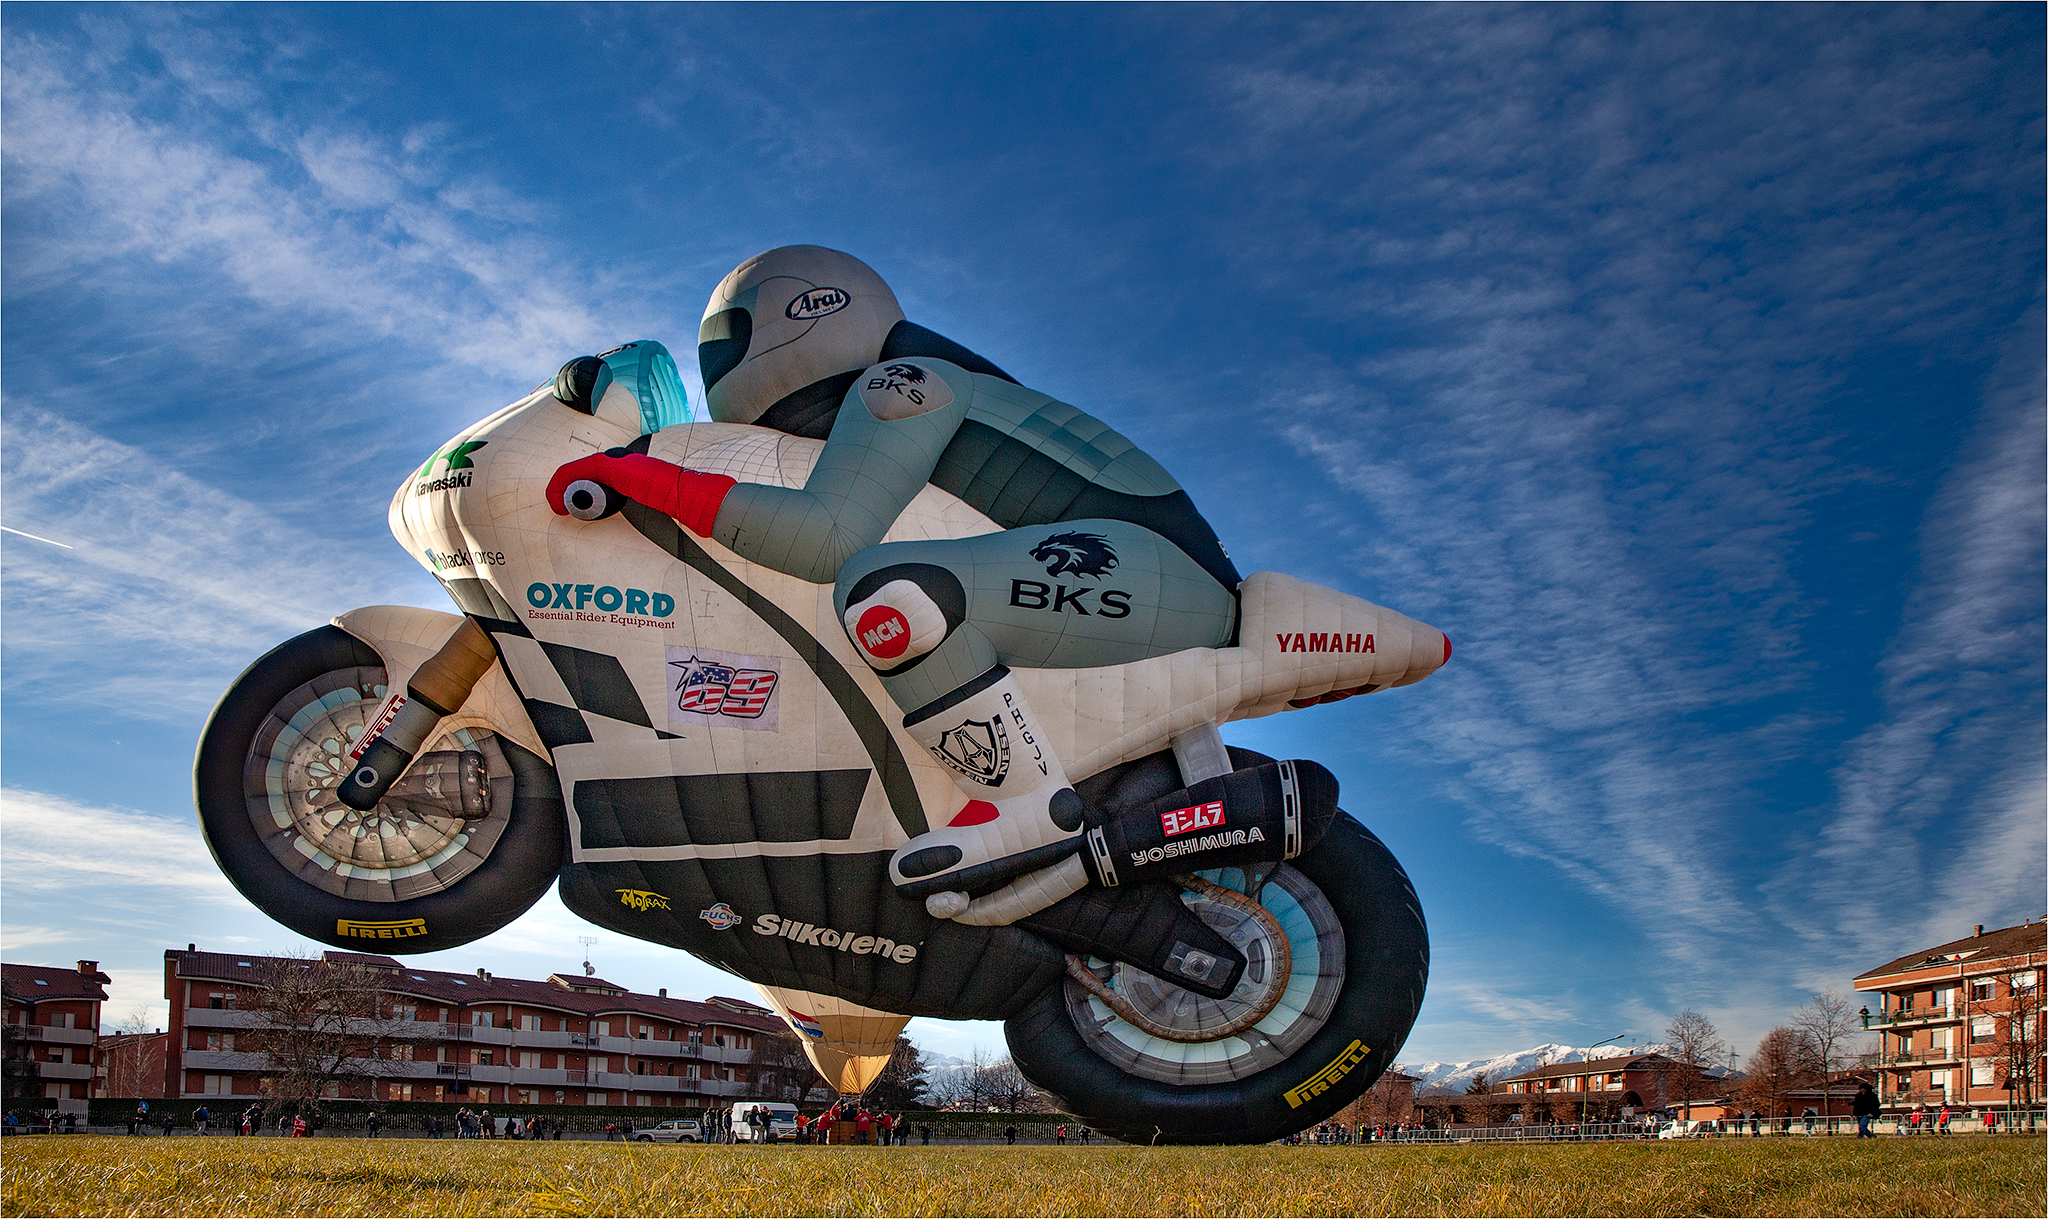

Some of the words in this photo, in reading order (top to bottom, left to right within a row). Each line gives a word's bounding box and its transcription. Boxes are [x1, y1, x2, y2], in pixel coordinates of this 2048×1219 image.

[793, 289, 844, 318] Arai
[867, 378, 926, 406] BKS
[526, 582, 676, 618] OXFORD
[1009, 578, 1133, 619] BKS
[528, 609, 574, 621] Essential
[576, 612, 607, 623] Rider
[610, 614, 675, 629] Equipment
[863, 617, 905, 649] MCN
[1276, 632, 1376, 654] YAMAHA
[677, 664, 779, 719] 69
[1163, 803, 1222, 835] ヨシムラ
[1131, 826, 1266, 867] YOSHIMURA
[337, 918, 428, 939] PIRELLI
[701, 911, 741, 924] FUCHS
[752, 913, 918, 965] Silkolene
[1283, 1039, 1372, 1109] PIRELLI
